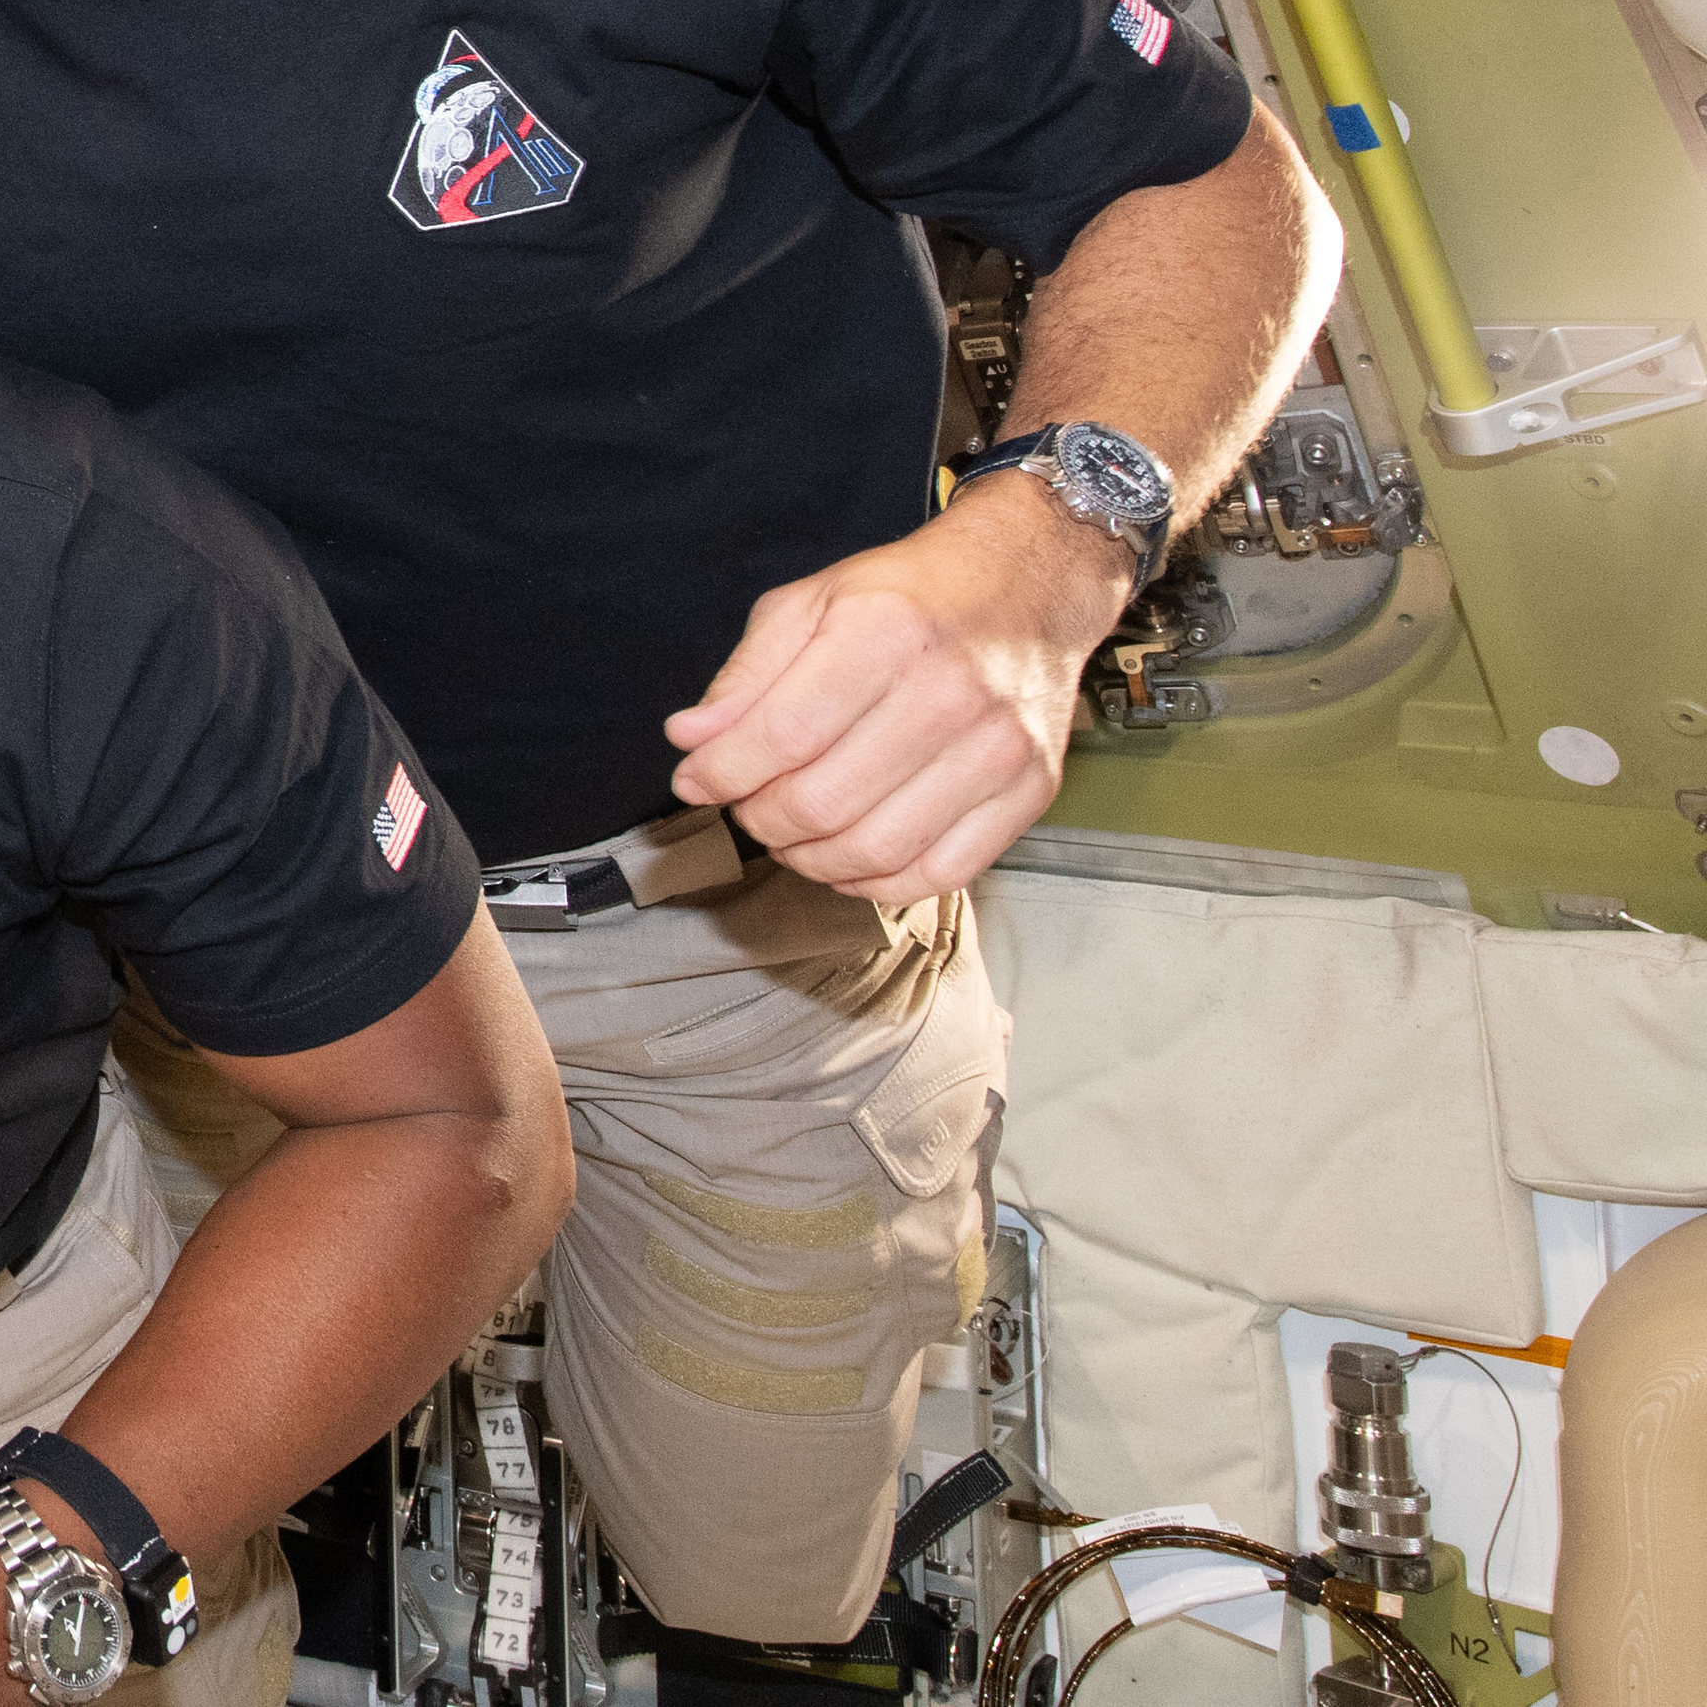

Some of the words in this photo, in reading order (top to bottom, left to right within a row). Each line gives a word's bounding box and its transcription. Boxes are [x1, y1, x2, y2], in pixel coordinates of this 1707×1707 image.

[964, 341, 998, 350] Gearbox
[1564, 434, 1606, 445] STBD
[486, 1416, 516, 1437] 78
[496, 1461, 526, 1480] 77
[501, 1547, 530, 1567] 74
[496, 1588, 525, 1609] 73
[491, 1631, 520, 1653] 72
[1448, 1633, 1492, 1664] N2
